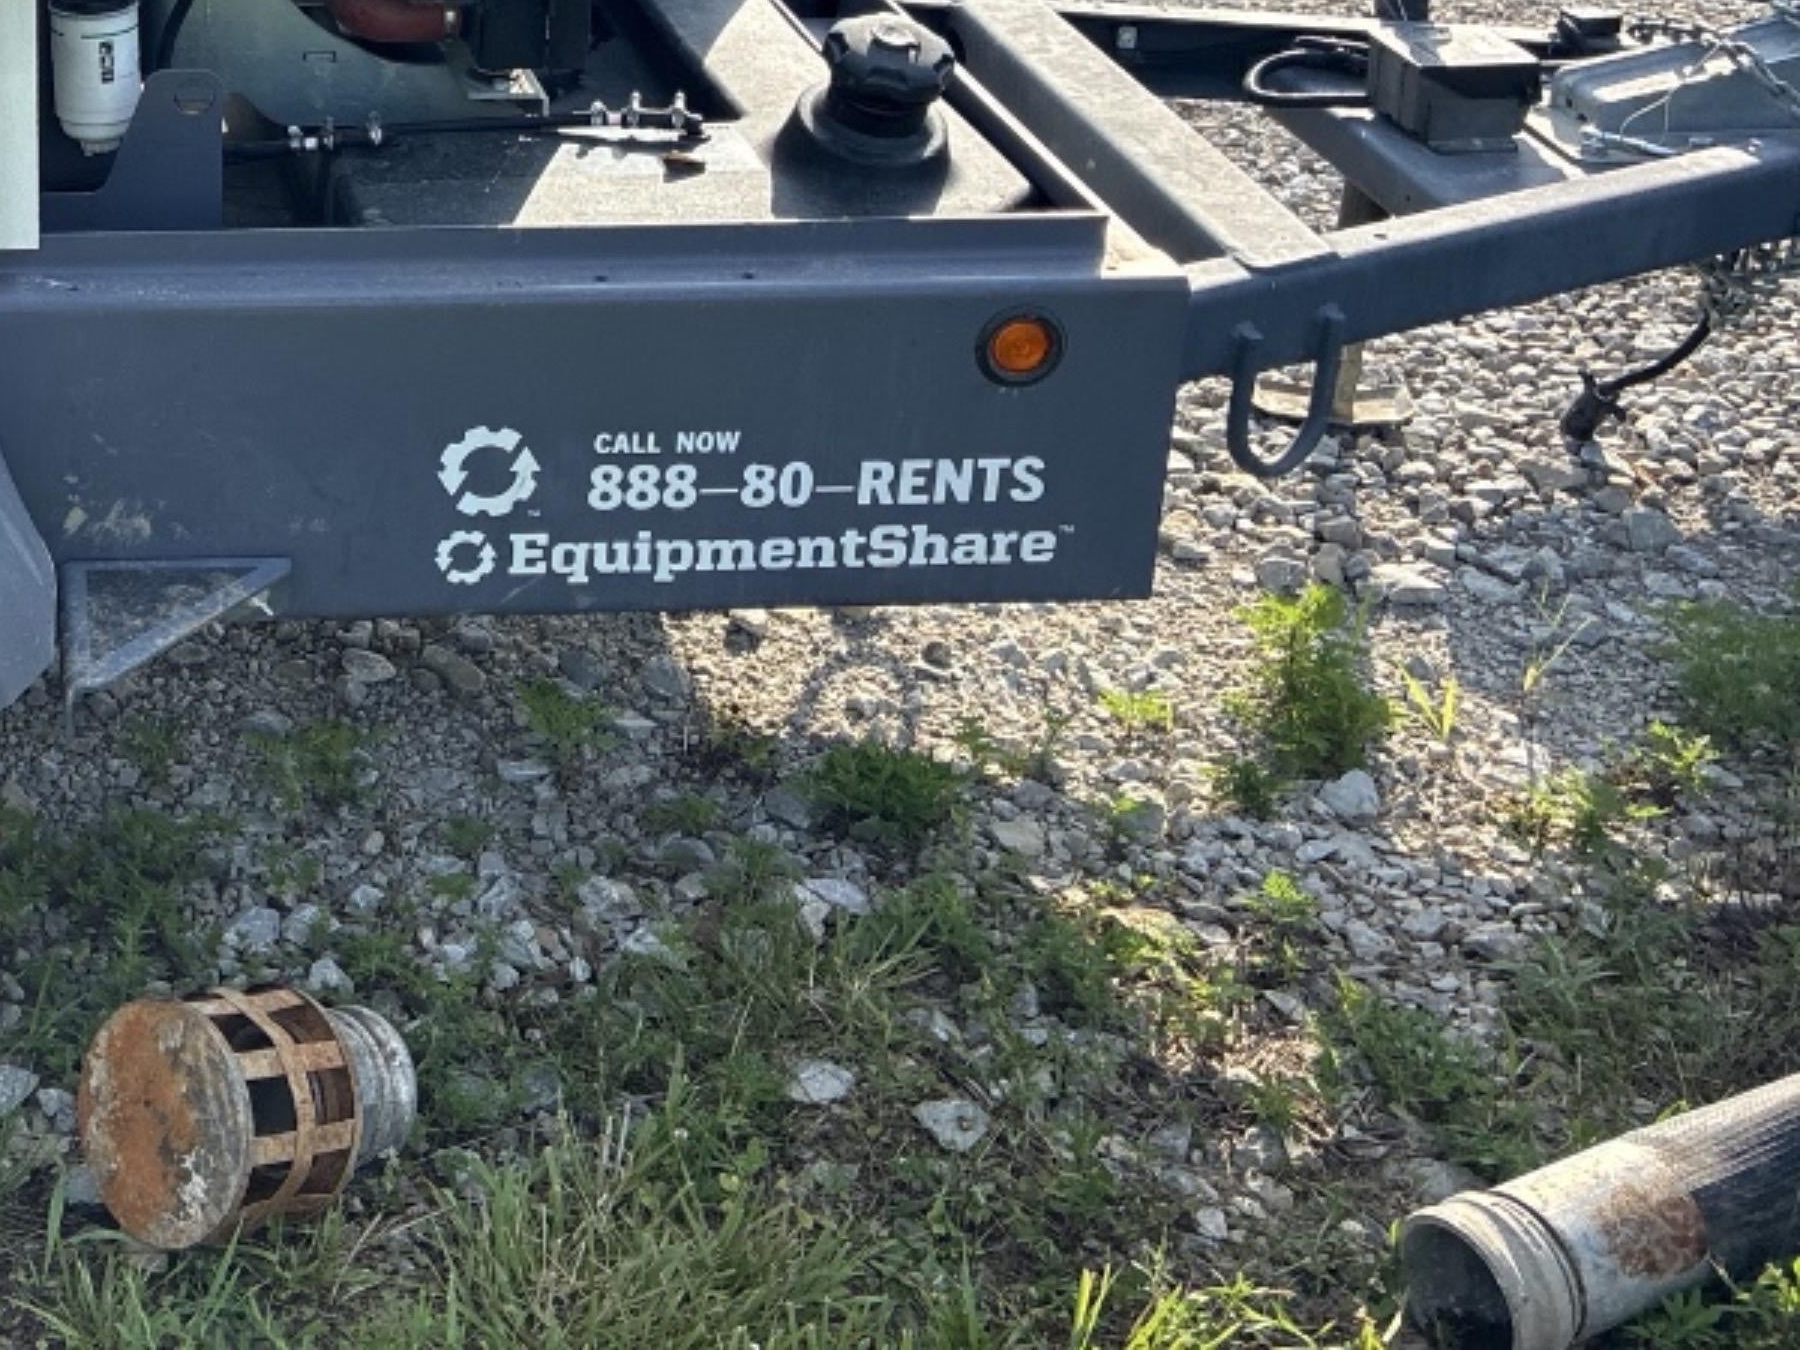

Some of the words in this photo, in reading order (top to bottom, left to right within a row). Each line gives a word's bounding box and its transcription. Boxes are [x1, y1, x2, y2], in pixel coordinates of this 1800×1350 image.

[593, 431, 661, 455] CALL
[675, 430, 742, 453] NOW
[586, 455, 1046, 511] 888-80-RENTS
[507, 523, 1058, 583] EquipmentShare
